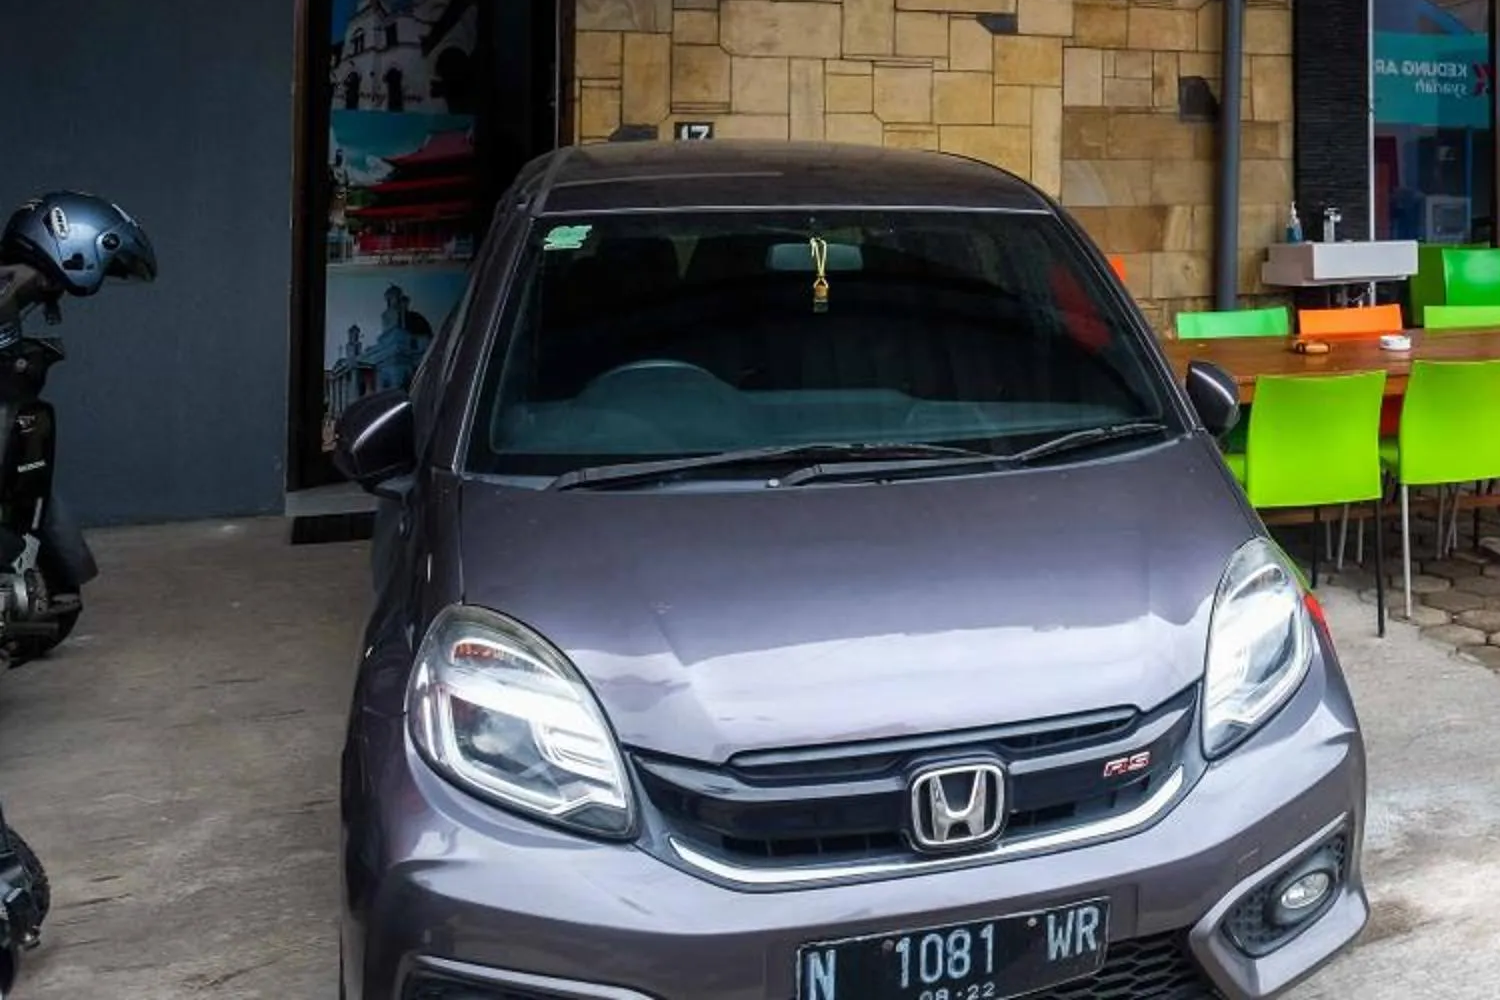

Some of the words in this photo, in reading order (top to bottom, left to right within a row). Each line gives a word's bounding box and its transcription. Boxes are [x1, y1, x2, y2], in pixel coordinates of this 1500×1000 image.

[681, 124, 709, 141] 17
[1104, 751, 1151, 777] RS
[808, 949, 836, 1000] N
[896, 924, 996, 988] 1081
[1048, 905, 1100, 961] WR
